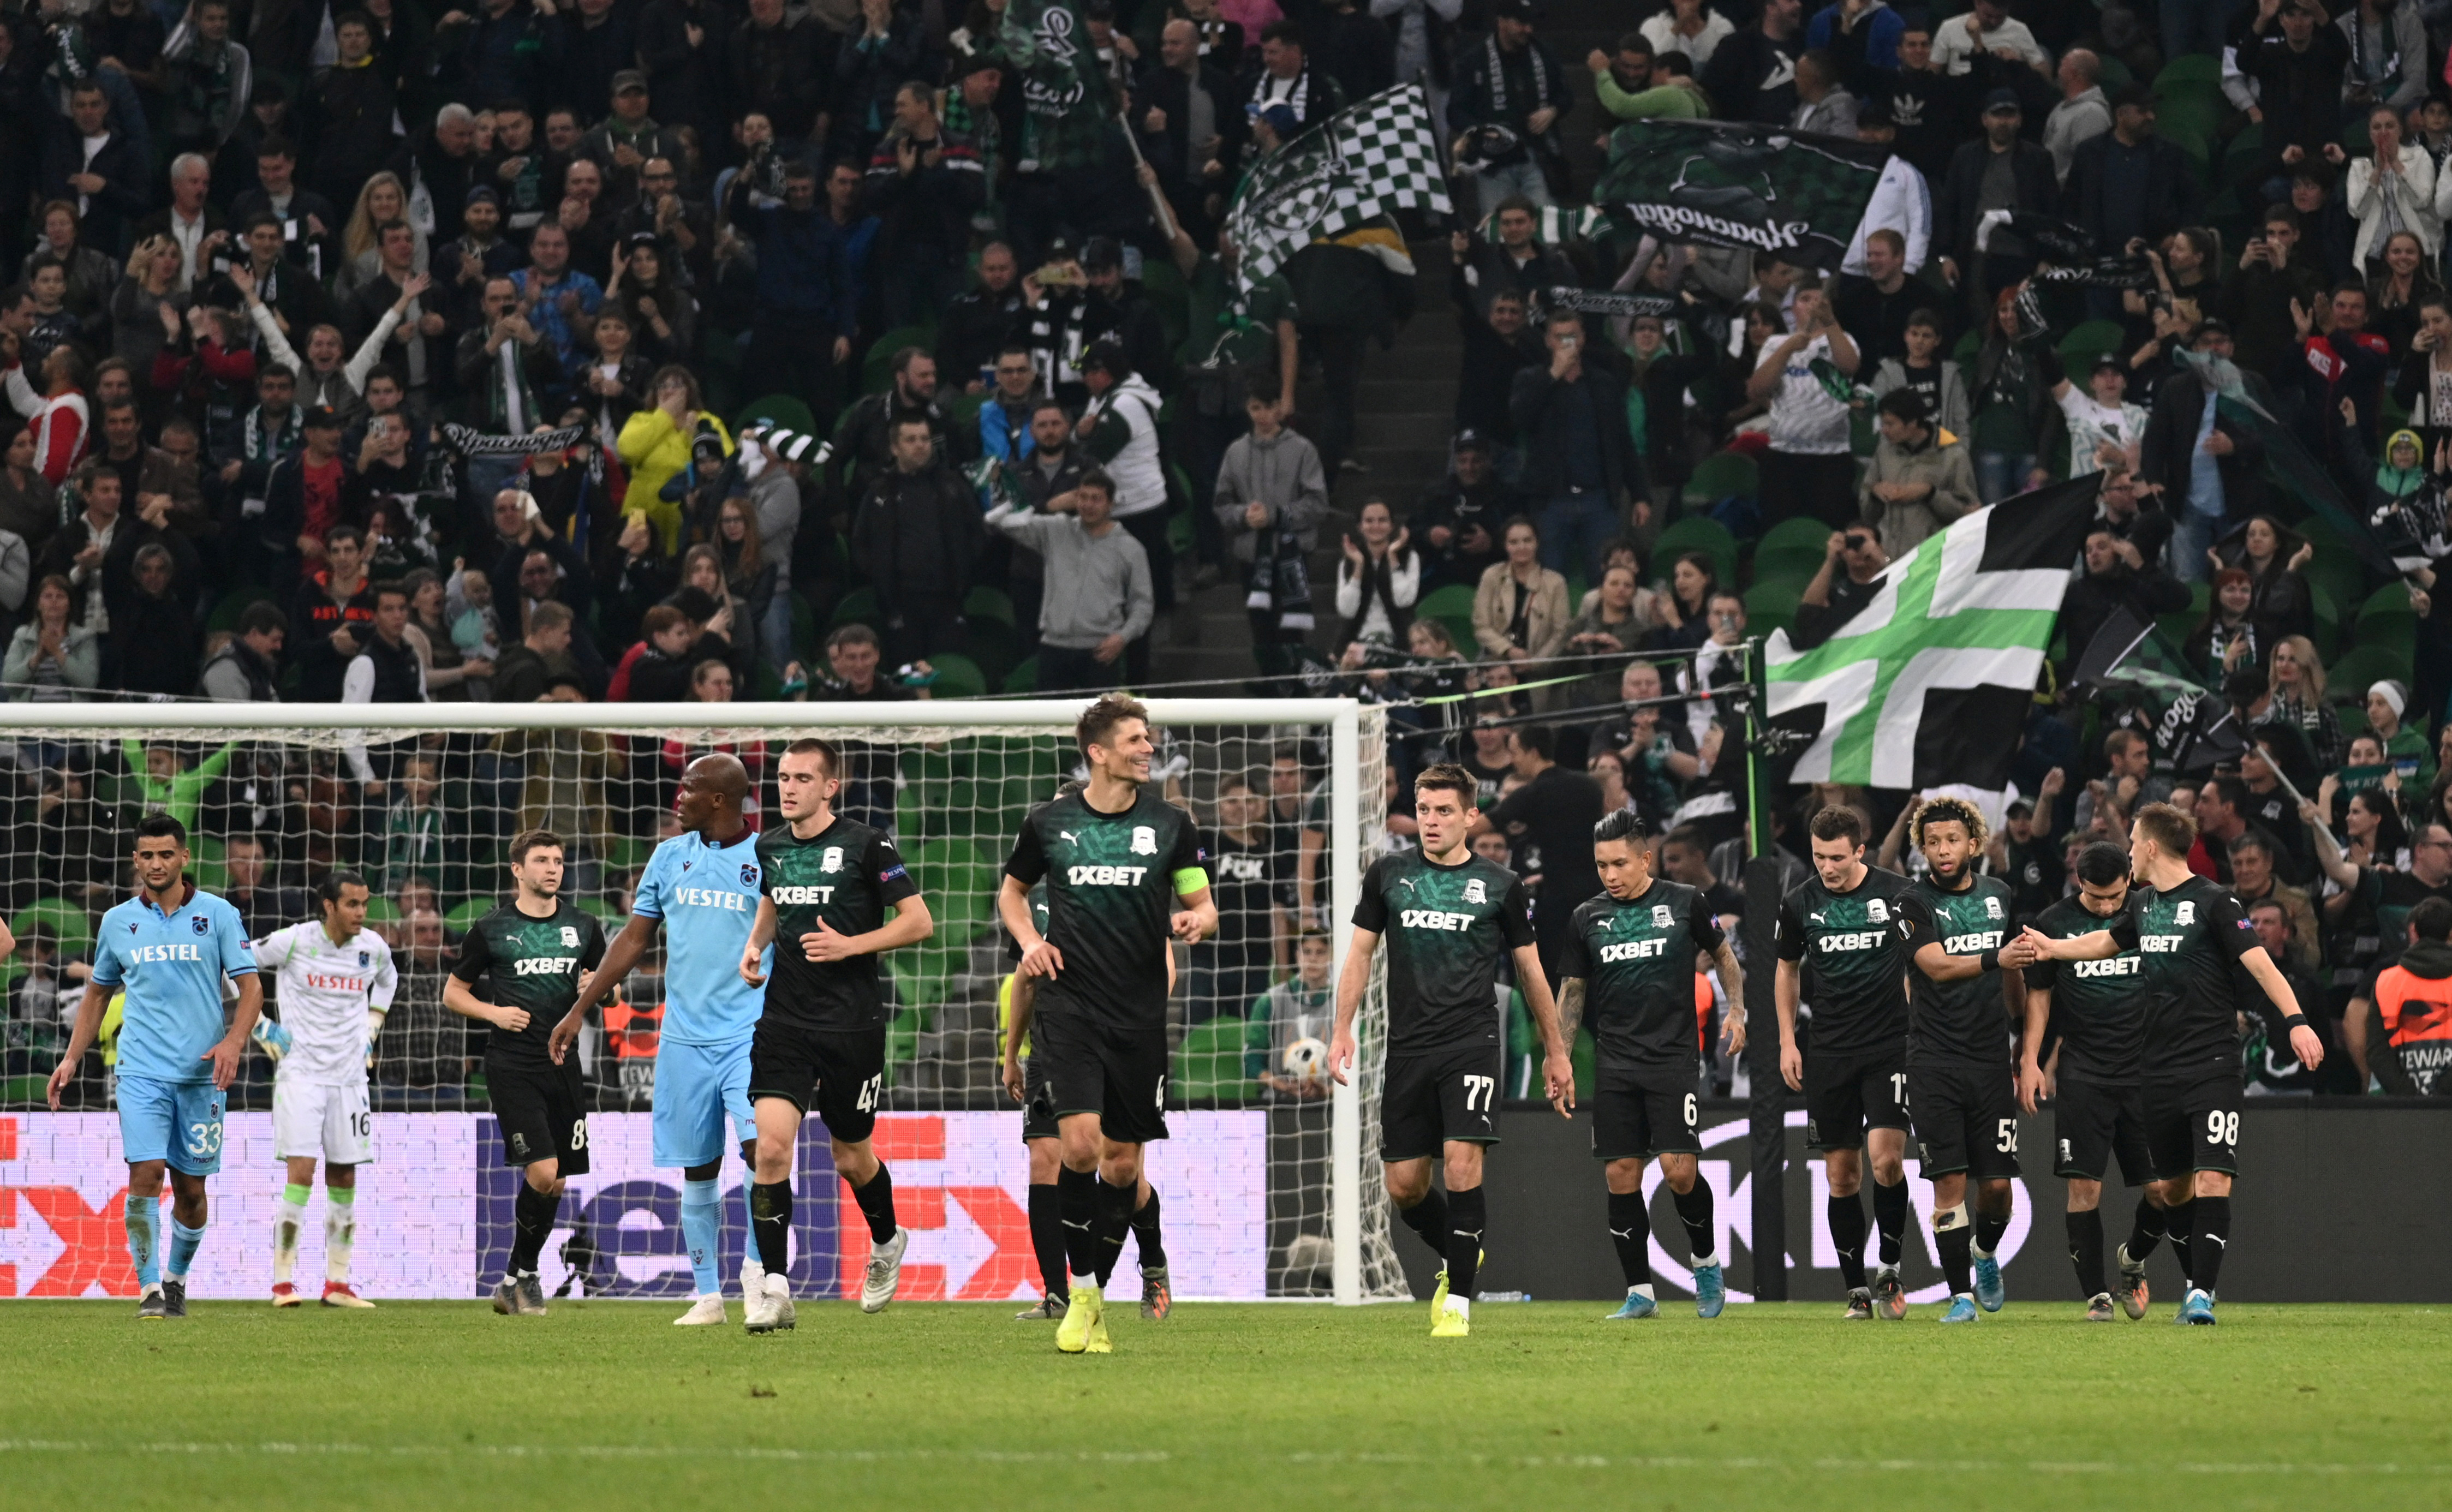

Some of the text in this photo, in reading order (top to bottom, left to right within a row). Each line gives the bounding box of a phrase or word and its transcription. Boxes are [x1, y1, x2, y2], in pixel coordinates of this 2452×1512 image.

[1067, 865, 1148, 886] 1XBET
[1219, 854, 1264, 880] FCK
[676, 888, 747, 912] VESTEL
[771, 886, 835, 904] 1XBET
[1400, 910, 1475, 932] 1XBET
[1600, 937, 1667, 963] 1XBET
[1818, 930, 1887, 953] 1XBET
[1944, 930, 2004, 954] 1XBET
[130, 945, 201, 964] VESTEL
[514, 958, 577, 975] 1XBET
[2073, 956, 2141, 978] 1XBET
[307, 973, 364, 991] VESTEL
[856, 1072, 882, 1114] 47
[1464, 1074, 1495, 1112] 77
[1684, 1092, 1698, 1126] 6
[350, 1111, 371, 1137] 16
[2206, 1109, 2239, 1146] 98
[188, 1122, 223, 1154] 33
